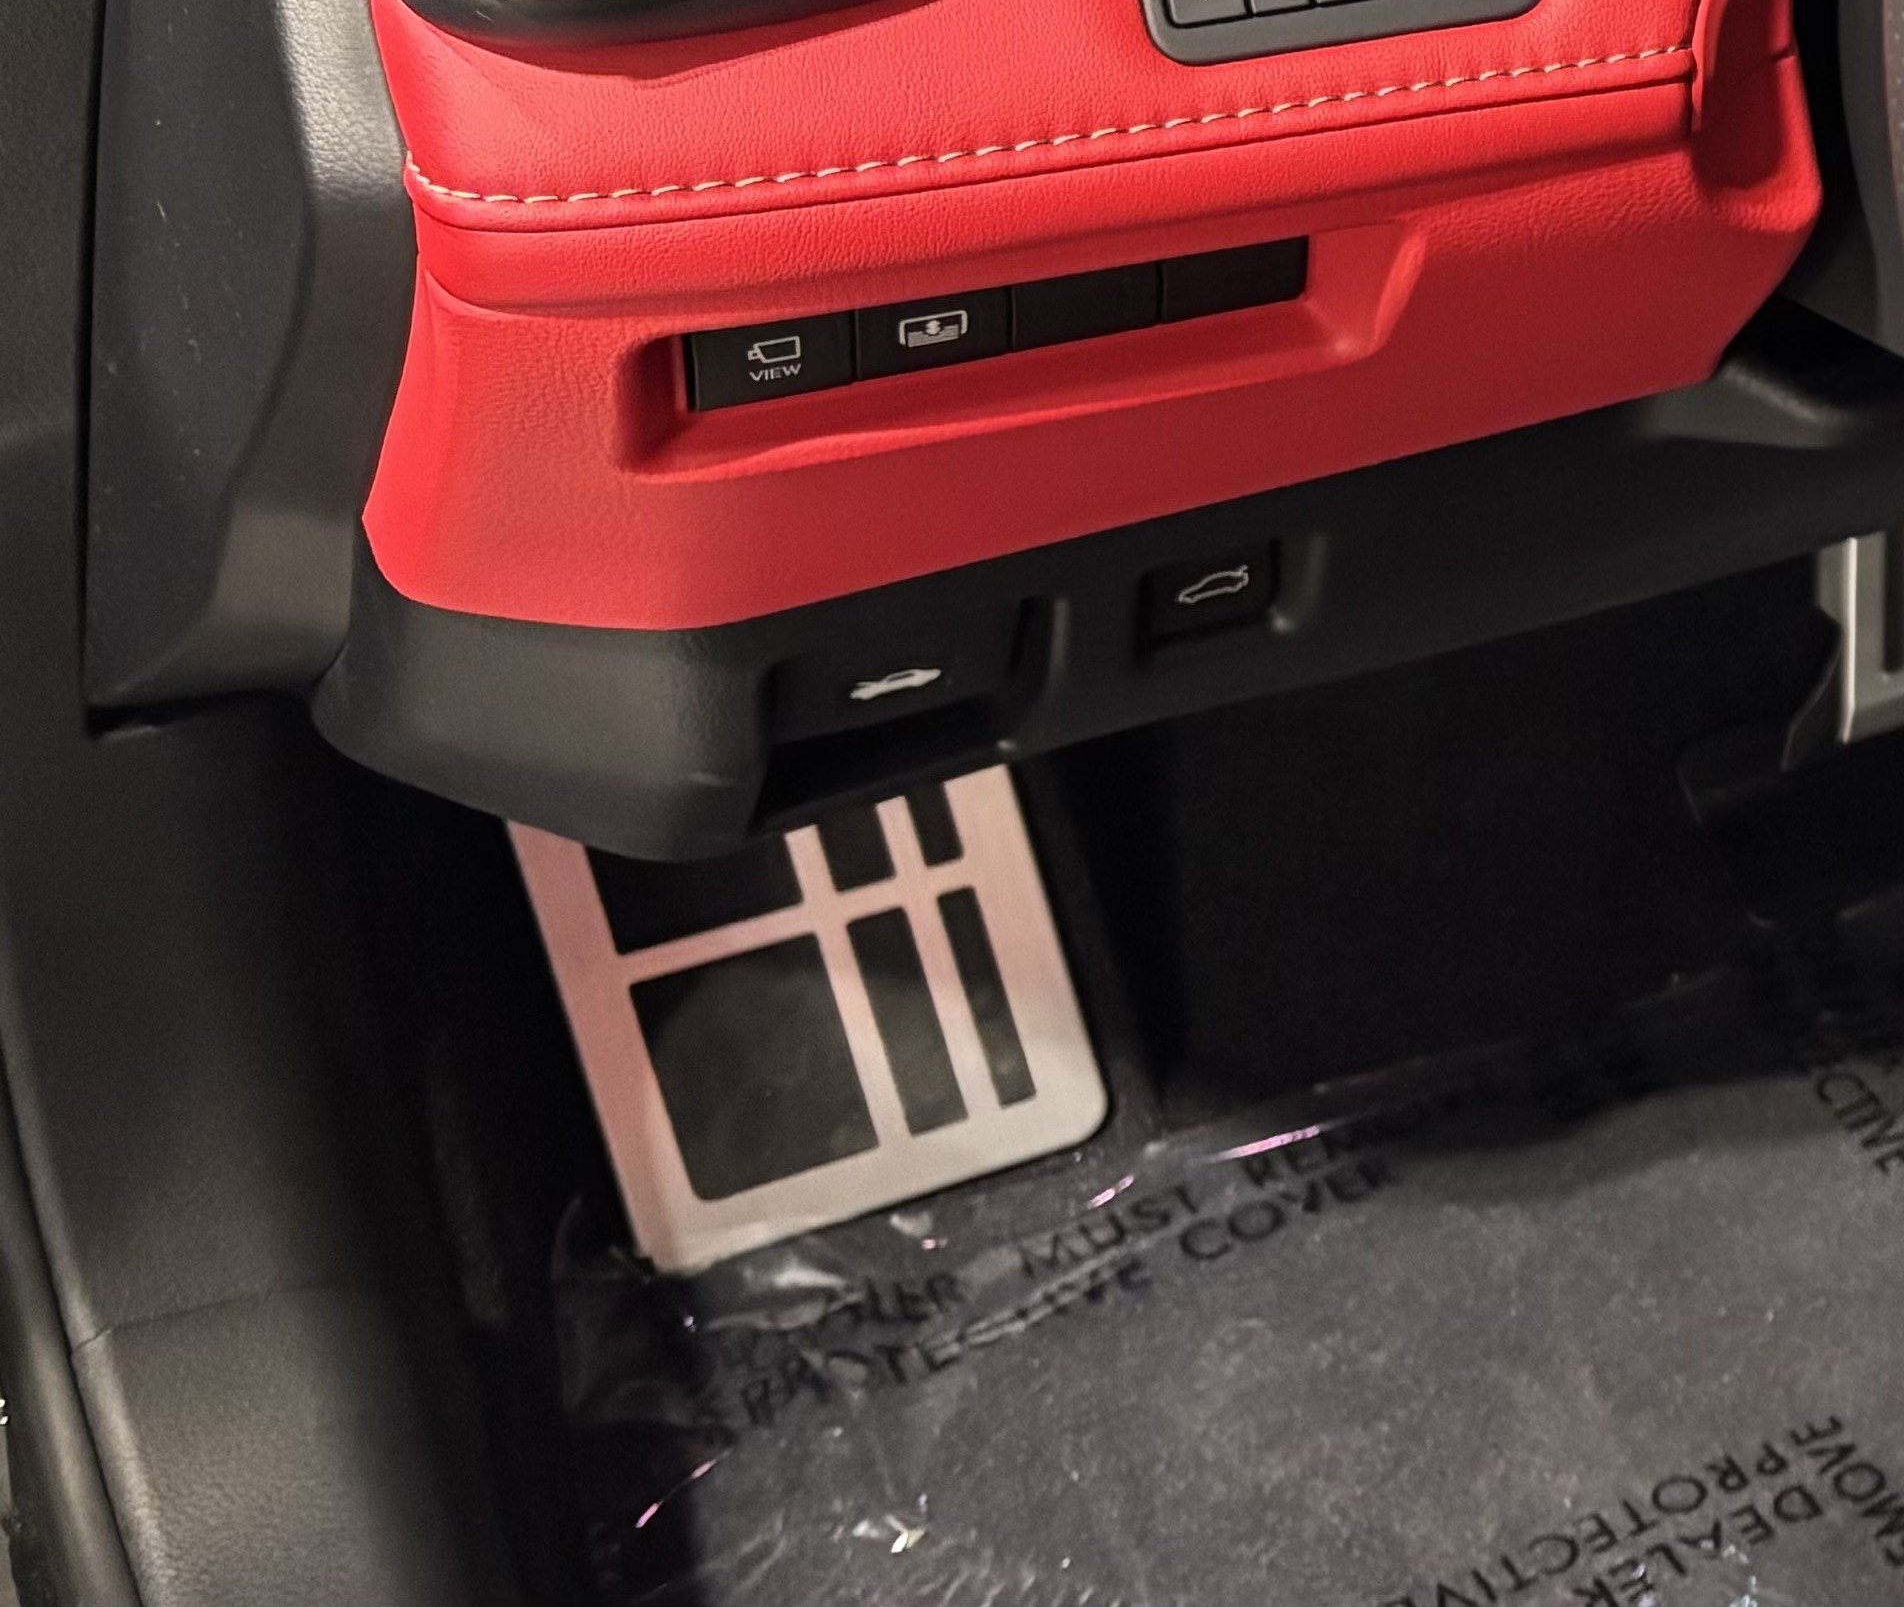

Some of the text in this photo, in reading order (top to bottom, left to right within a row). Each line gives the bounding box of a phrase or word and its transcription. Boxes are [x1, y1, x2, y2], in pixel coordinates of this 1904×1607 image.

[749, 362, 801, 383] VIEW
[1180, 1156, 1405, 1262] COVER
[1378, 1442, 1790, 1607] PROTECTIV
